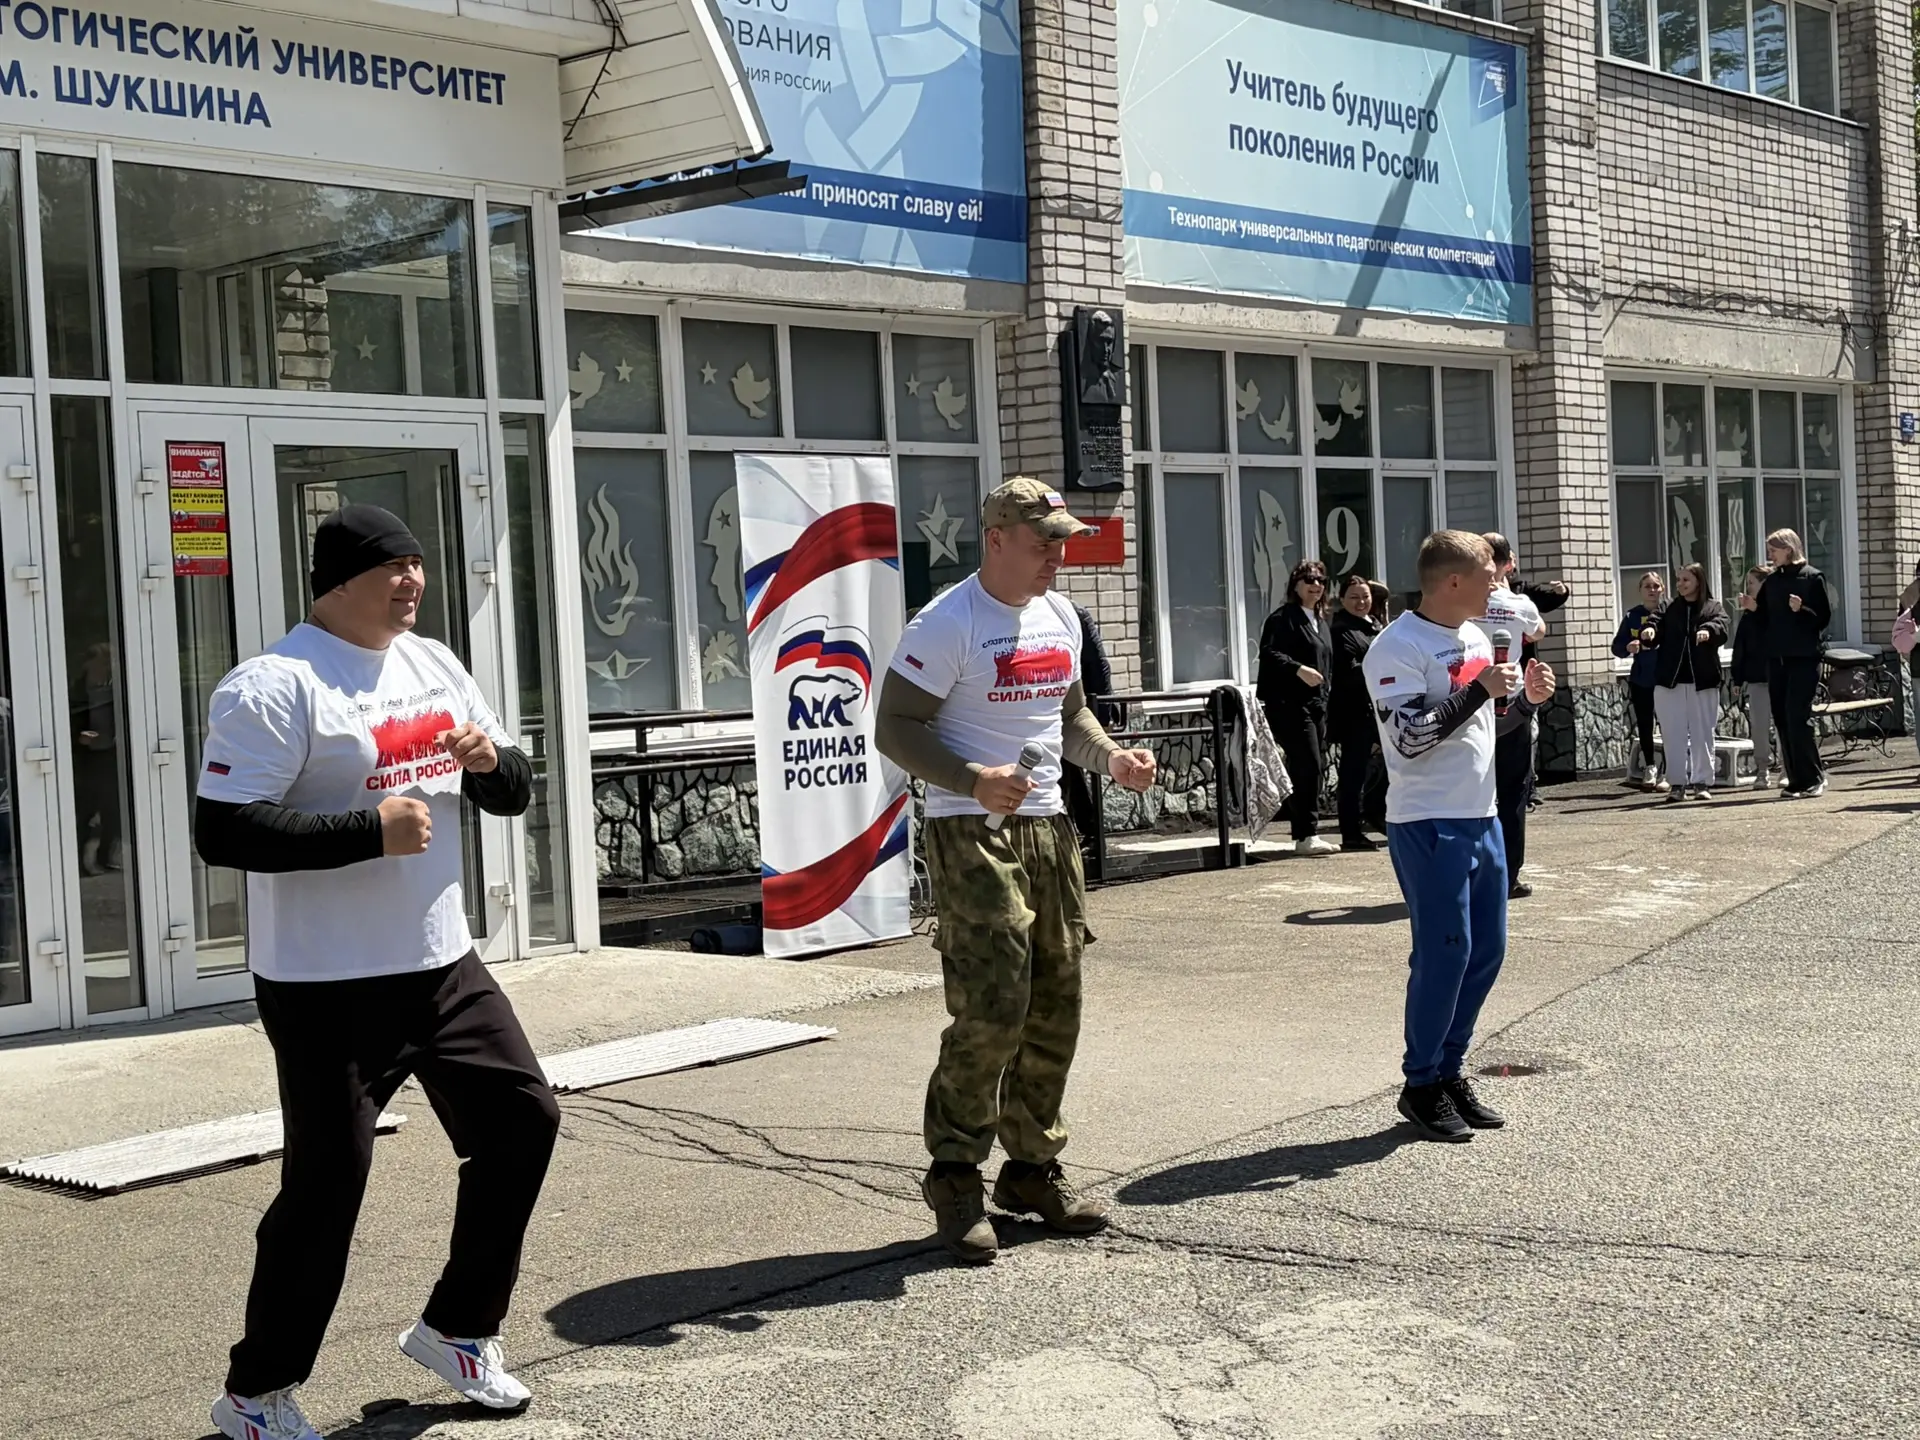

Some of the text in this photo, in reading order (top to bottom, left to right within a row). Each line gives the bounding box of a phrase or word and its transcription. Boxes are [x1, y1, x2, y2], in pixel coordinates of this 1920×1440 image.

[53, 65, 272, 128] ШУКШИНА
[272, 38, 507, 106] УНИВЕРСИТЕТ
[774, 71, 832, 94] РОССИИ
[1225, 59, 1439, 135] Учитель будущего
[1229, 123, 1440, 185] поколения России
[811, 180, 899, 211] приносят
[903, 194, 953, 223] славу
[957, 198, 984, 223] ей!
[1168, 206, 1497, 268] Технопарк универсальных педагогических компетенций
[1326, 506, 1360, 576] 9
[987, 690, 1033, 702] СИЛА
[783, 734, 867, 766] ЕДИНАЯ
[365, 772, 412, 791] СИЛА
[784, 762, 868, 791] РОССИЯ
